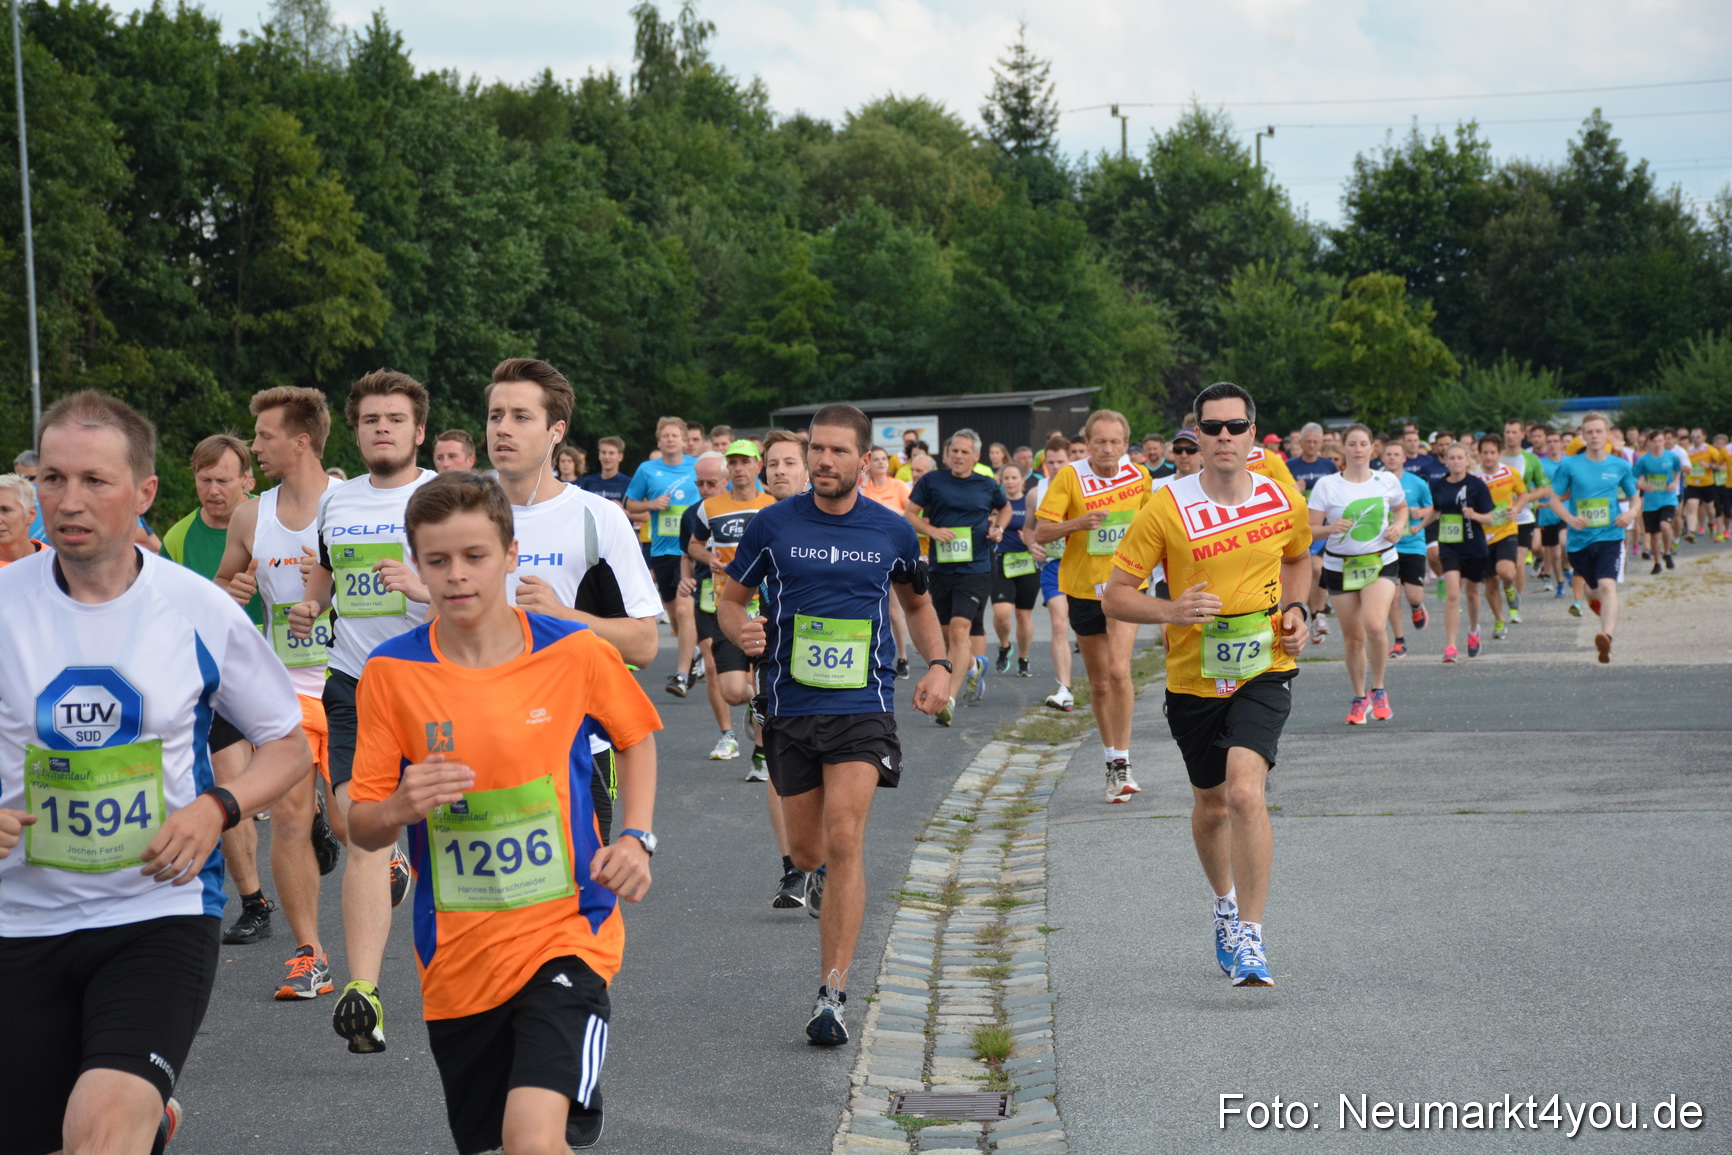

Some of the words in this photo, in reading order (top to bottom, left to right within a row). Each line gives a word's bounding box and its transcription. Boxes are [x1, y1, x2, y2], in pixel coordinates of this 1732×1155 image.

[1085, 495, 1115, 511] MAX
[1118, 485, 1146, 500] BÖGL
[1581, 509, 1607, 520] 1095
[332, 523, 407, 537] DELPH
[729, 525, 744, 534] Fis
[940, 540, 968, 552] 1309
[1192, 535, 1242, 562] MAX
[1246, 519, 1293, 544] BÖGL
[790, 541, 828, 560] EURO
[842, 550, 881, 564] POLES
[345, 573, 388, 596] 286
[807, 645, 854, 669] 364
[1217, 640, 1261, 663] 873
[60, 702, 116, 725] TÜV
[76, 730, 102, 742] SÜD
[42, 768, 92, 782] firmenlauf
[41, 790, 152, 838] 1594
[443, 811, 488, 823] firmenlauf
[67, 845, 97, 856] Jochen
[100, 844, 125, 855] Ferstl
[445, 828, 553, 877] 1296
[457, 884, 488, 895] Hannes
[489, 876, 546, 895] Bierschneider
